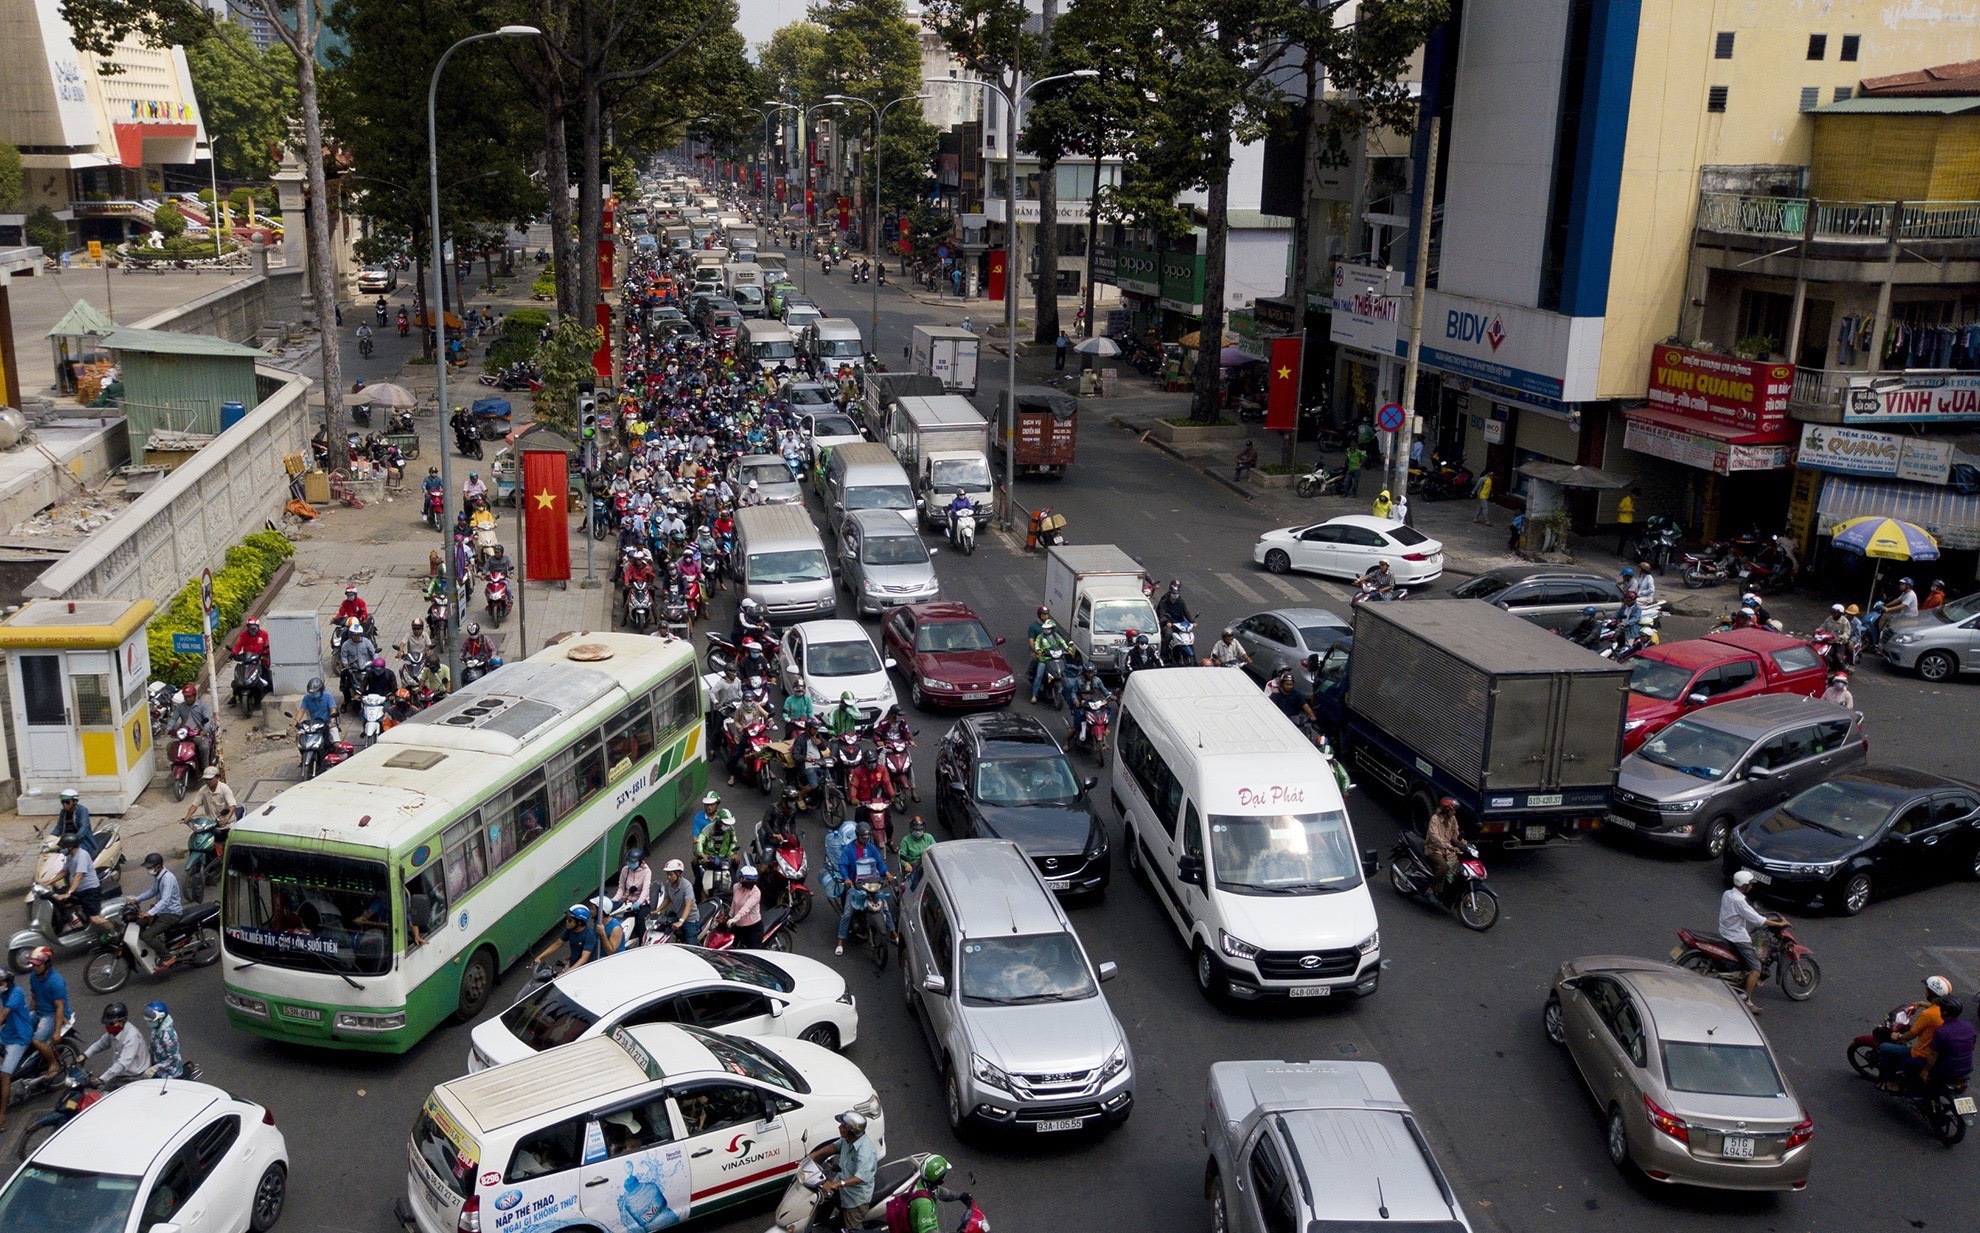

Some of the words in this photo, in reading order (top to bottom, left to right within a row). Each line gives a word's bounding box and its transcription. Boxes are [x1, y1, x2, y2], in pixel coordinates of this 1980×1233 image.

[1446, 309, 1488, 344] BIDV
[1658, 367, 1695, 390] VINH
[1696, 374, 1754, 402] QUANG
[1886, 391, 1933, 413] VINH
[1938, 390, 1980, 413] QUA
[1837, 430, 1859, 440] TIỆM
[1861, 431, 1879, 440] SỬA
[1827, 437, 1897, 460] QUANG
[3, 635, 25, 643] CẢNH
[1238, 787, 1267, 808] Đại
[1270, 785, 1305, 804] Phát
[307, 937, 322, 952] SUỐI
[323, 939, 338, 954] TIÊN
[1731, 1138, 1748, 1147] 51G
[1724, 1147, 1754, 1157] 494.54
[481, 1173, 500, 1186] 8296
[452, 1196, 461, 1207] 27
[532, 1194, 555, 1212] THAO
[533, 1204, 559, 1221] KHÔNG
